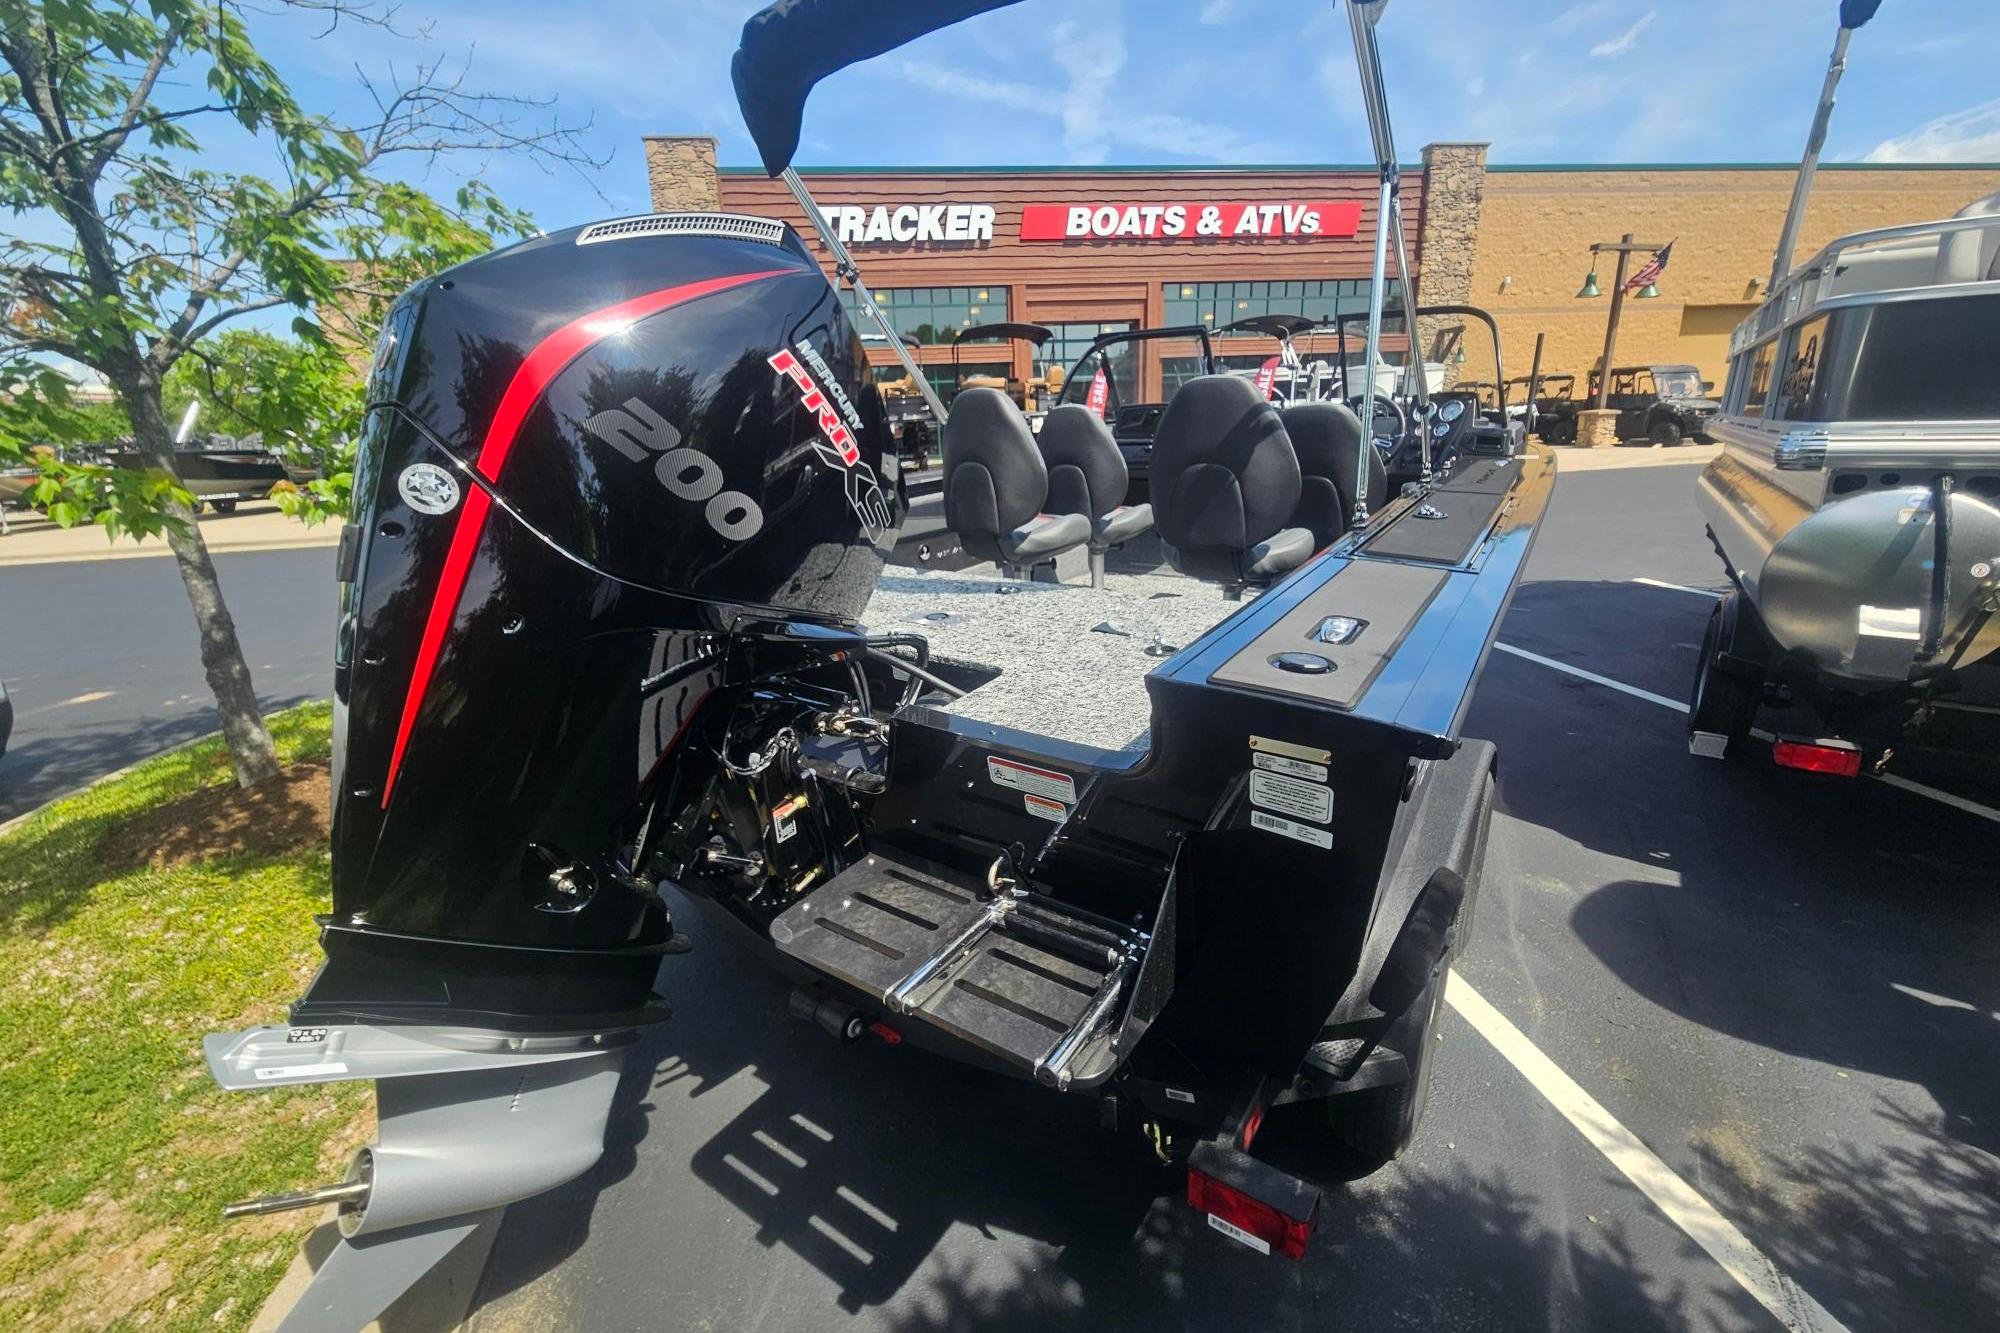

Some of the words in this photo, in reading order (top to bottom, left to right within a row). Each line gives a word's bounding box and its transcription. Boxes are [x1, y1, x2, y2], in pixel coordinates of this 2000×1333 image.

[819, 205, 996, 242] TRACKER
[1066, 205, 1187, 236] BOATS
[1196, 206, 1223, 235] &
[1234, 204, 1320, 234] ATVs
[767, 348, 861, 467] PRO
[796, 338, 865, 431] MERCURY
[1092, 374, 1107, 404] SALE
[583, 396, 764, 541] 200
[811, 441, 892, 545] XS
